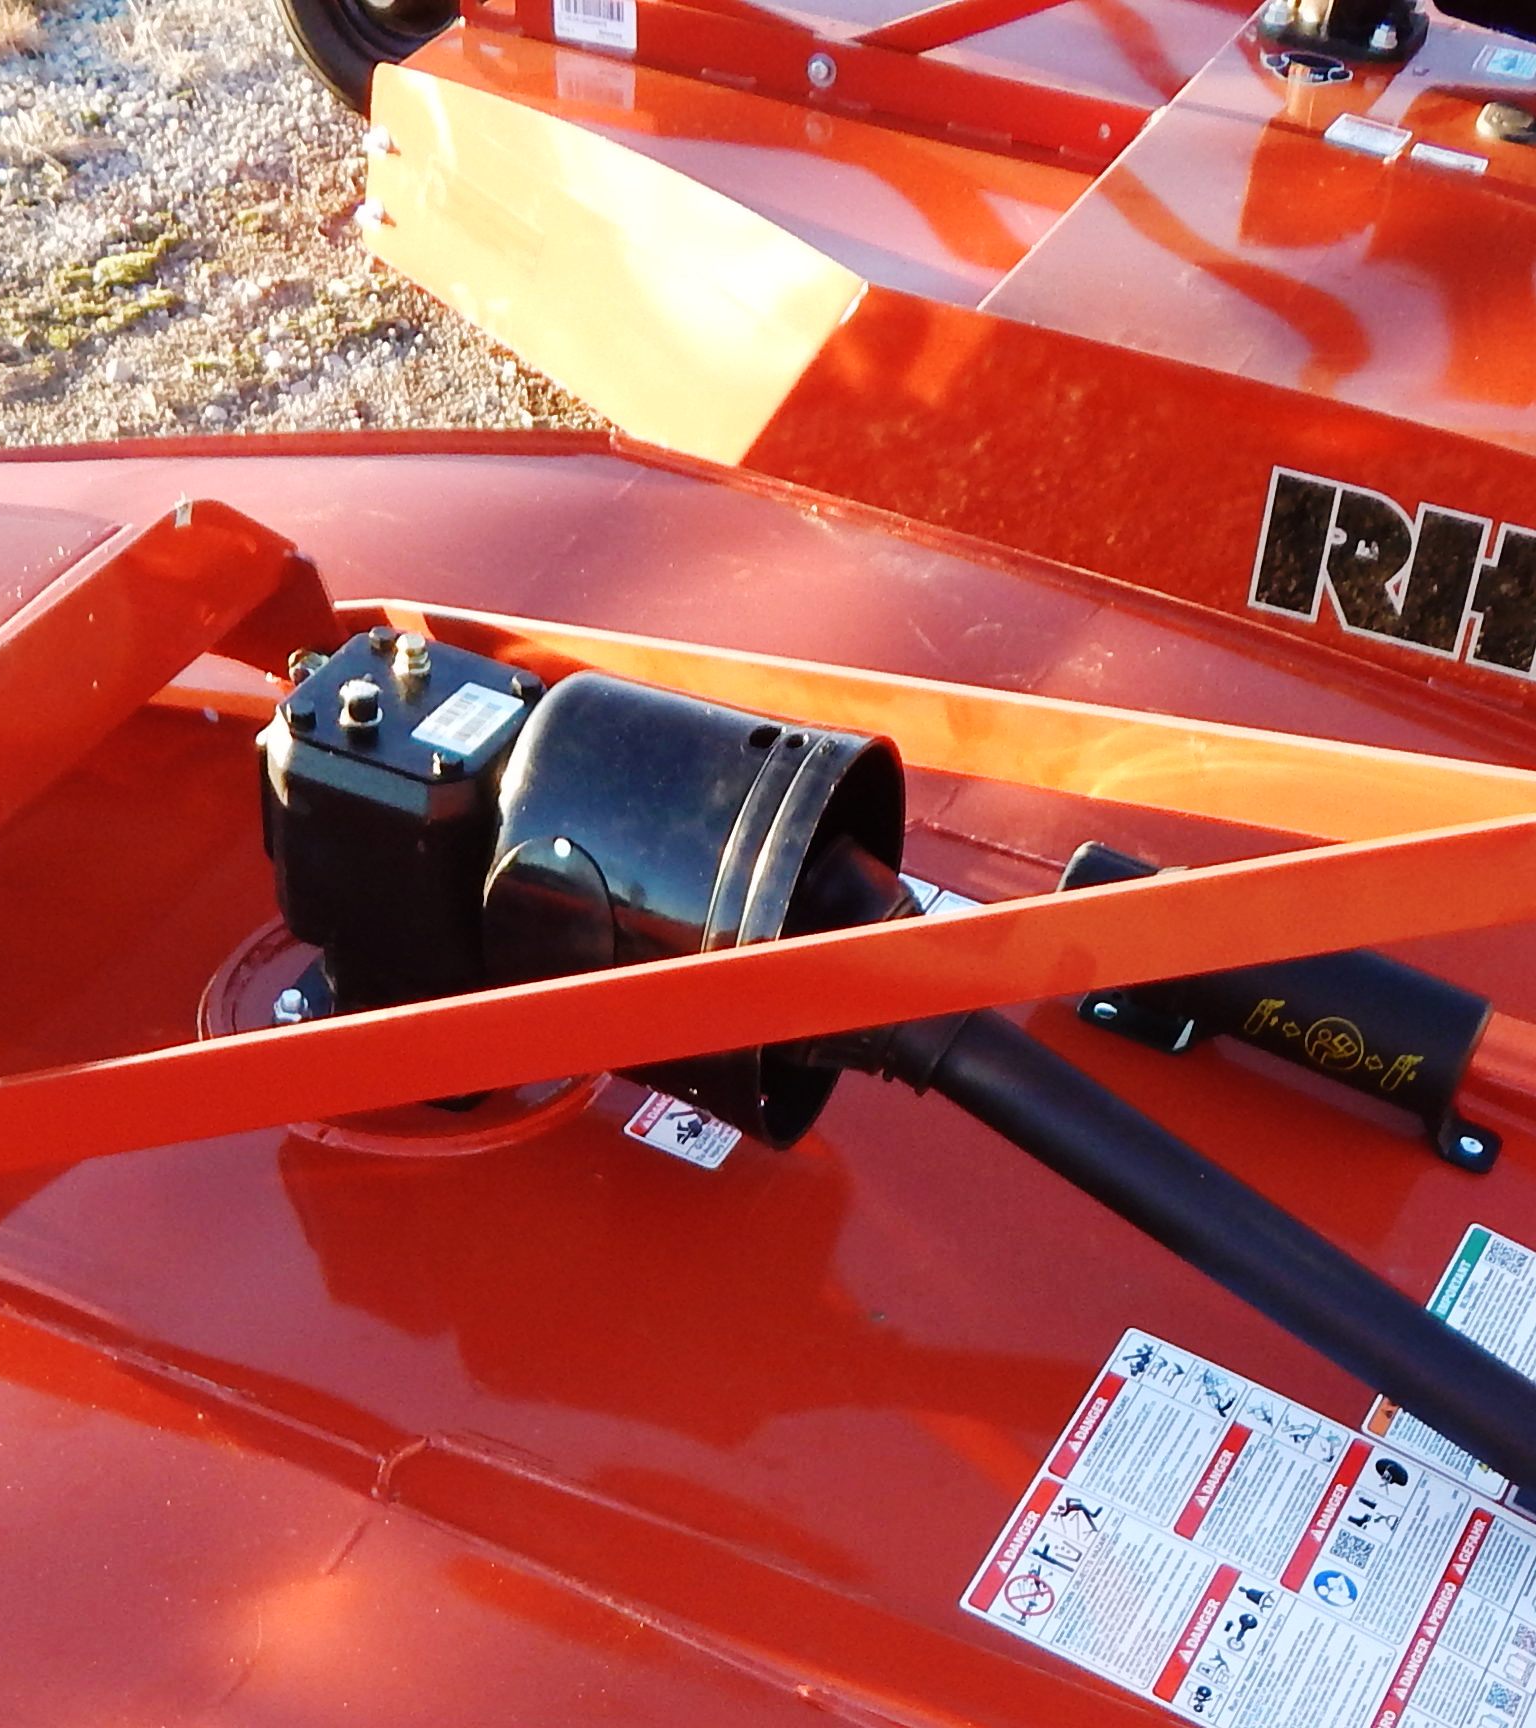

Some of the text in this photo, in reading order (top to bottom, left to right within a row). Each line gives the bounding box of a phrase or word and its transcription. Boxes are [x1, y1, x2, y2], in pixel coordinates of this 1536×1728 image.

[1435, 1258, 1472, 1315] IMPORTANT
[1071, 1393, 1109, 1444] DANGER
[1198, 1446, 1236, 1496] DANGER
[1314, 1480, 1348, 1530] DANGER
[1000, 1507, 1041, 1563] DANGER
[1184, 1595, 1220, 1651] DANGER
[1397, 1636, 1432, 1688] DANGER
[1427, 1581, 1457, 1626] PERIGO
[1456, 1517, 1488, 1566] GEFAHR
